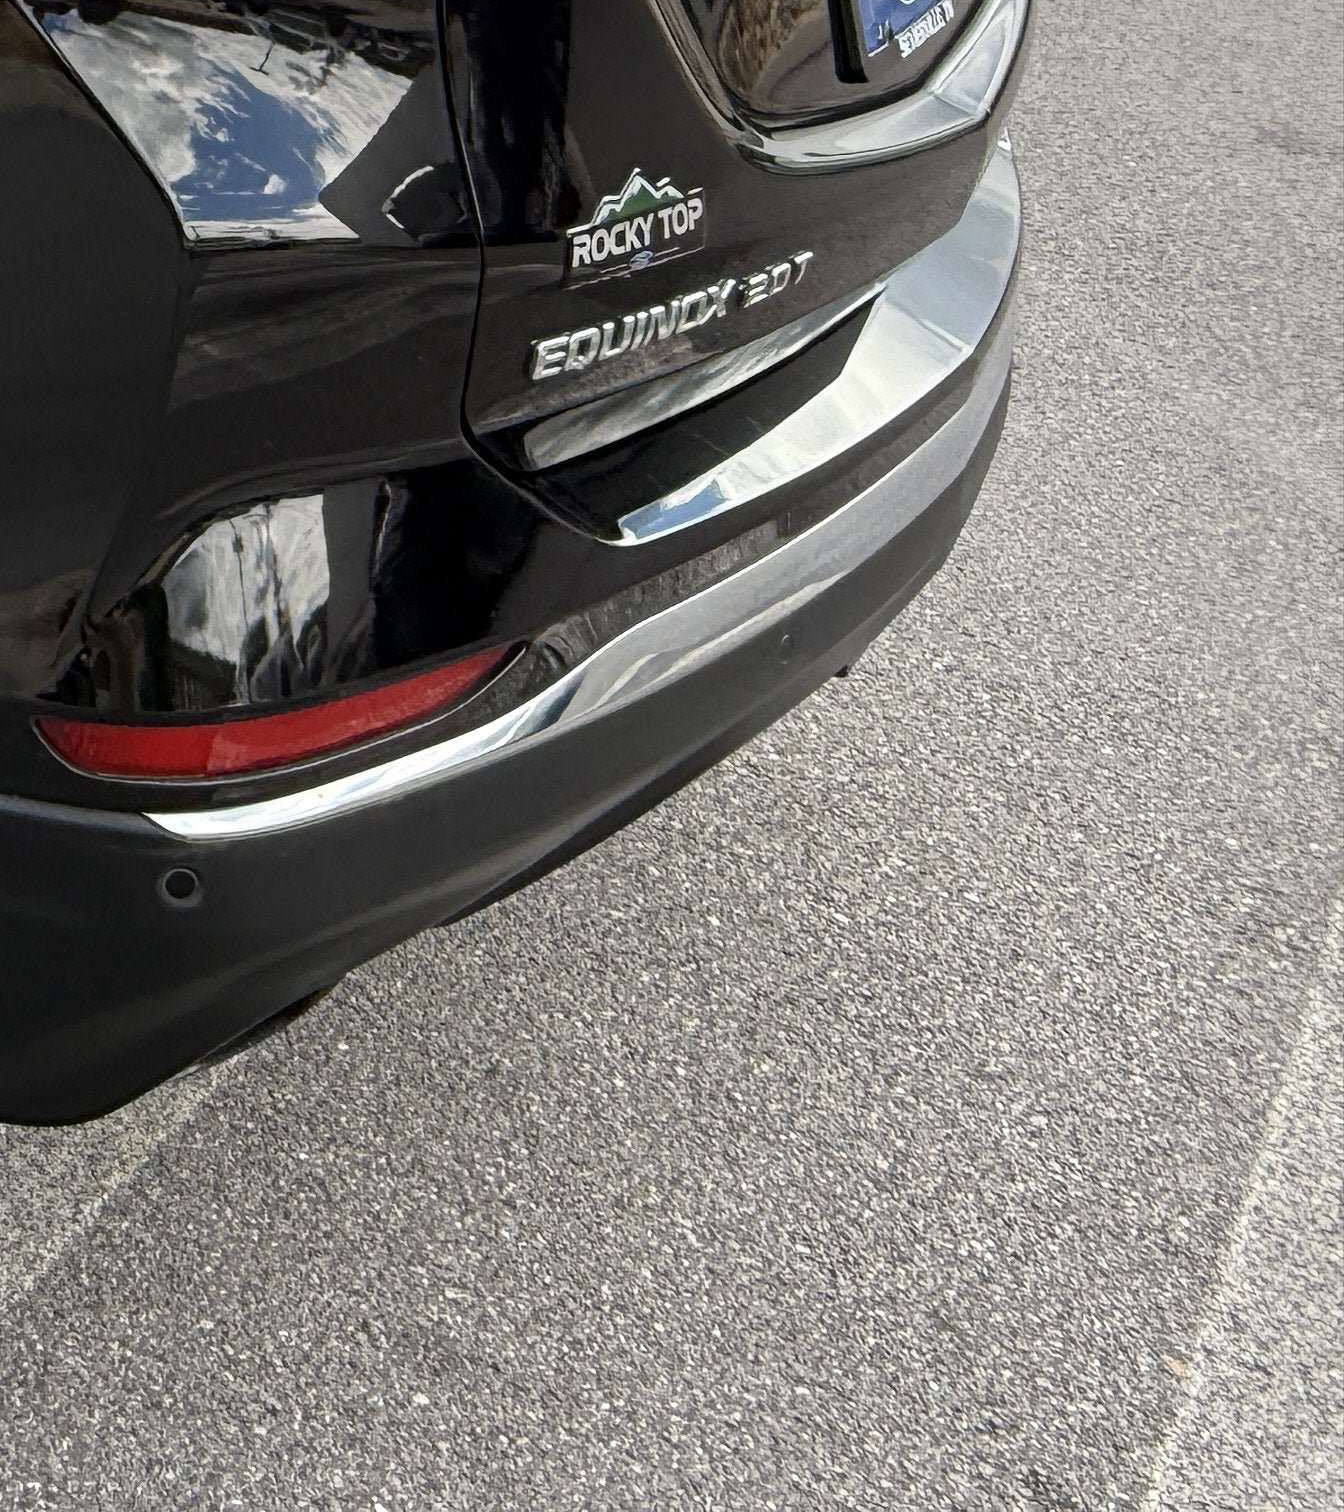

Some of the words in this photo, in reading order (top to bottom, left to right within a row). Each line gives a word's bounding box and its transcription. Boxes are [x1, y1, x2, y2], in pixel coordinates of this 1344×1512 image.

[571, 212, 655, 269] ROCKY
[658, 197, 704, 239] TOP
[531, 278, 736, 381] EQUINOX
